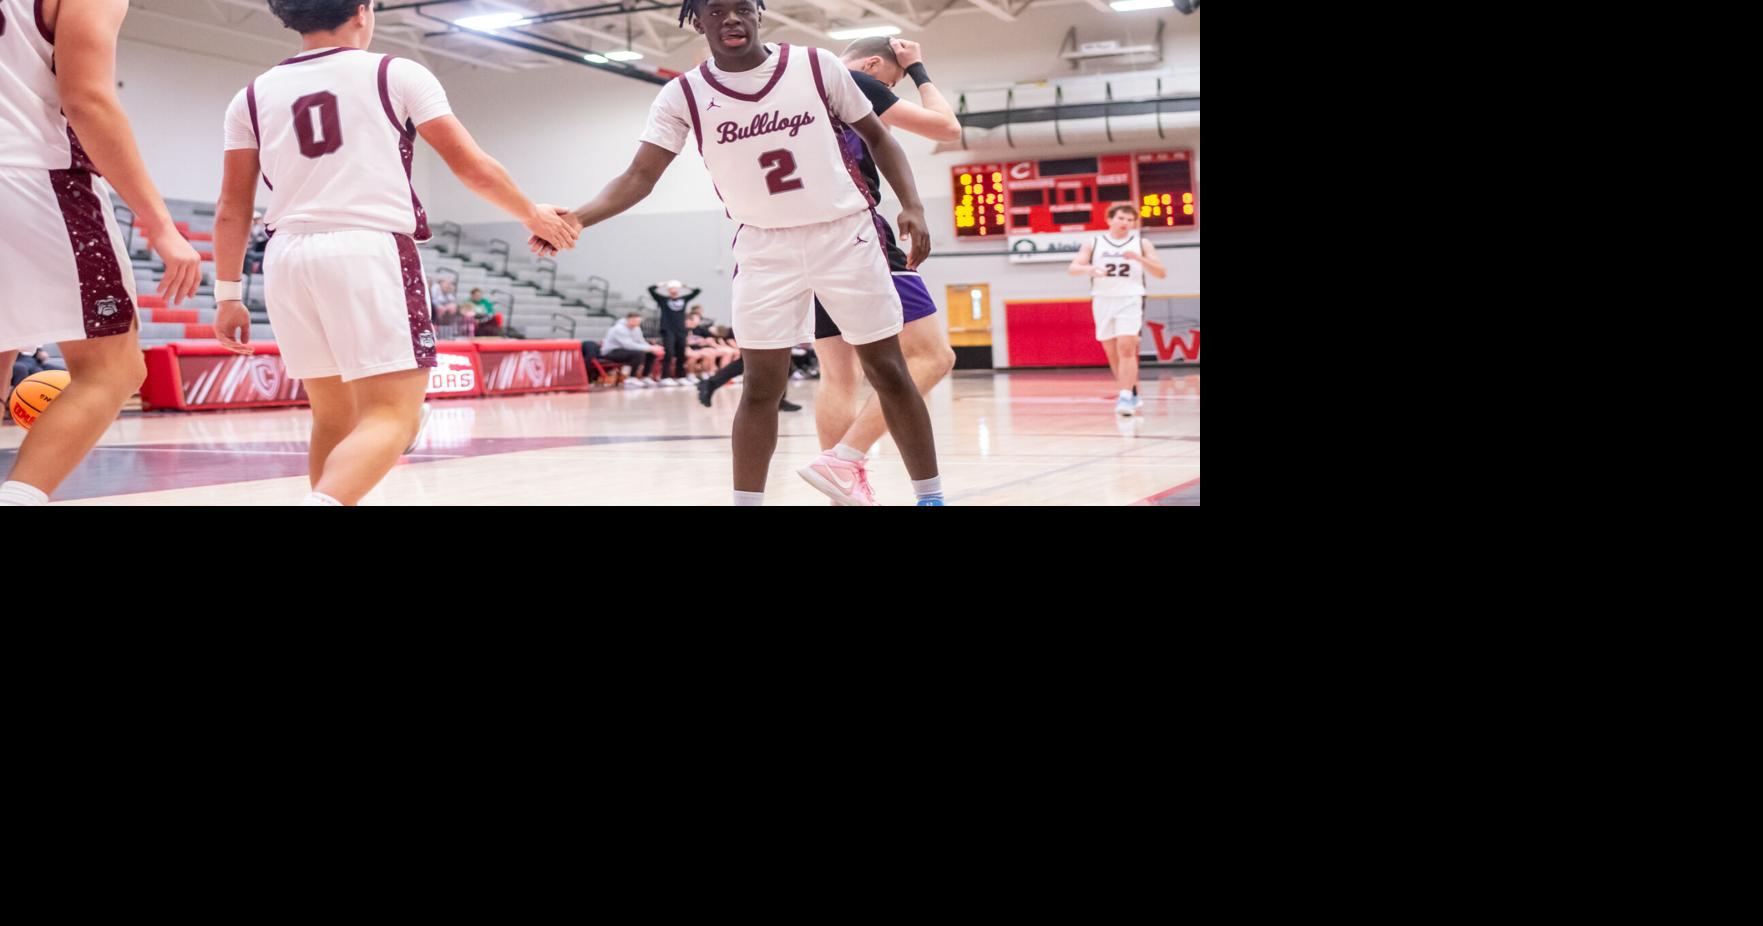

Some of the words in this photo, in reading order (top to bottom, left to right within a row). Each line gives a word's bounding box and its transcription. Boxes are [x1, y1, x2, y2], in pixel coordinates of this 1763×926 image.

[291, 90, 344, 159] 0
[716, 110, 815, 144] Bulldogs
[757, 148, 804, 195] 2
[1010, 161, 1031, 179] C
[1105, 263, 1130, 277] 22
